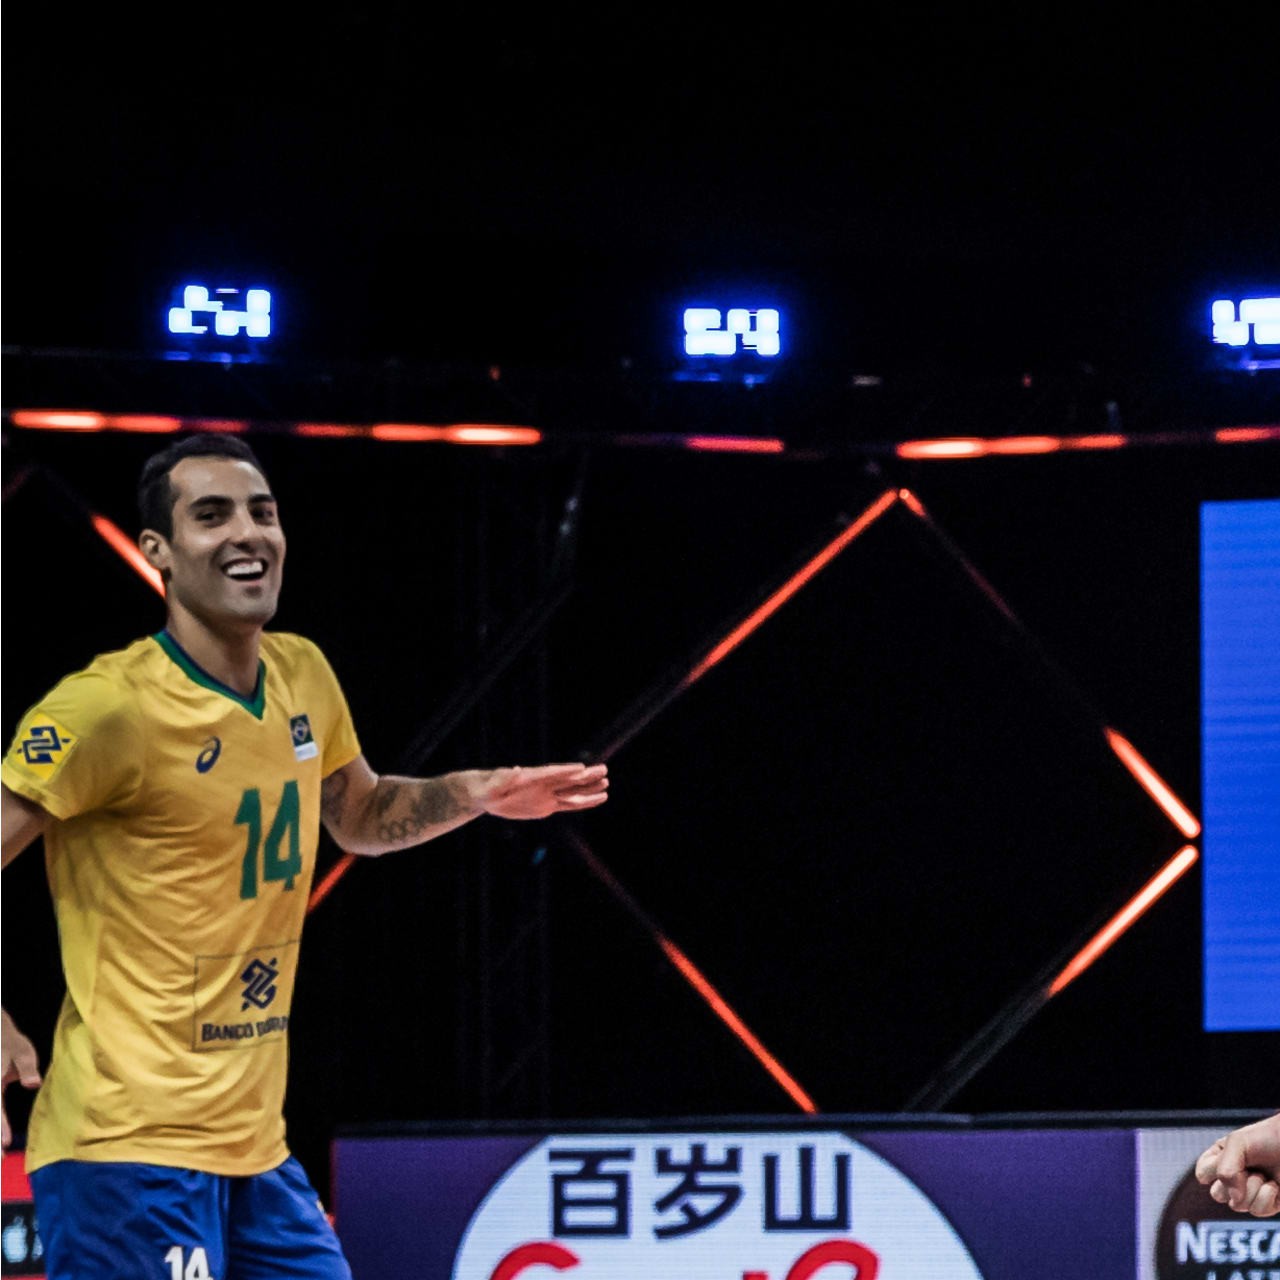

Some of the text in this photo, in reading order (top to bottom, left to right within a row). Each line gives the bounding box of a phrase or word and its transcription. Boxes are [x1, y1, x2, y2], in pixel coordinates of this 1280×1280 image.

[233, 780, 303, 901] 14
[202, 1022, 254, 1042] BANCO
[548, 1143, 853, 1240] 百岁山
